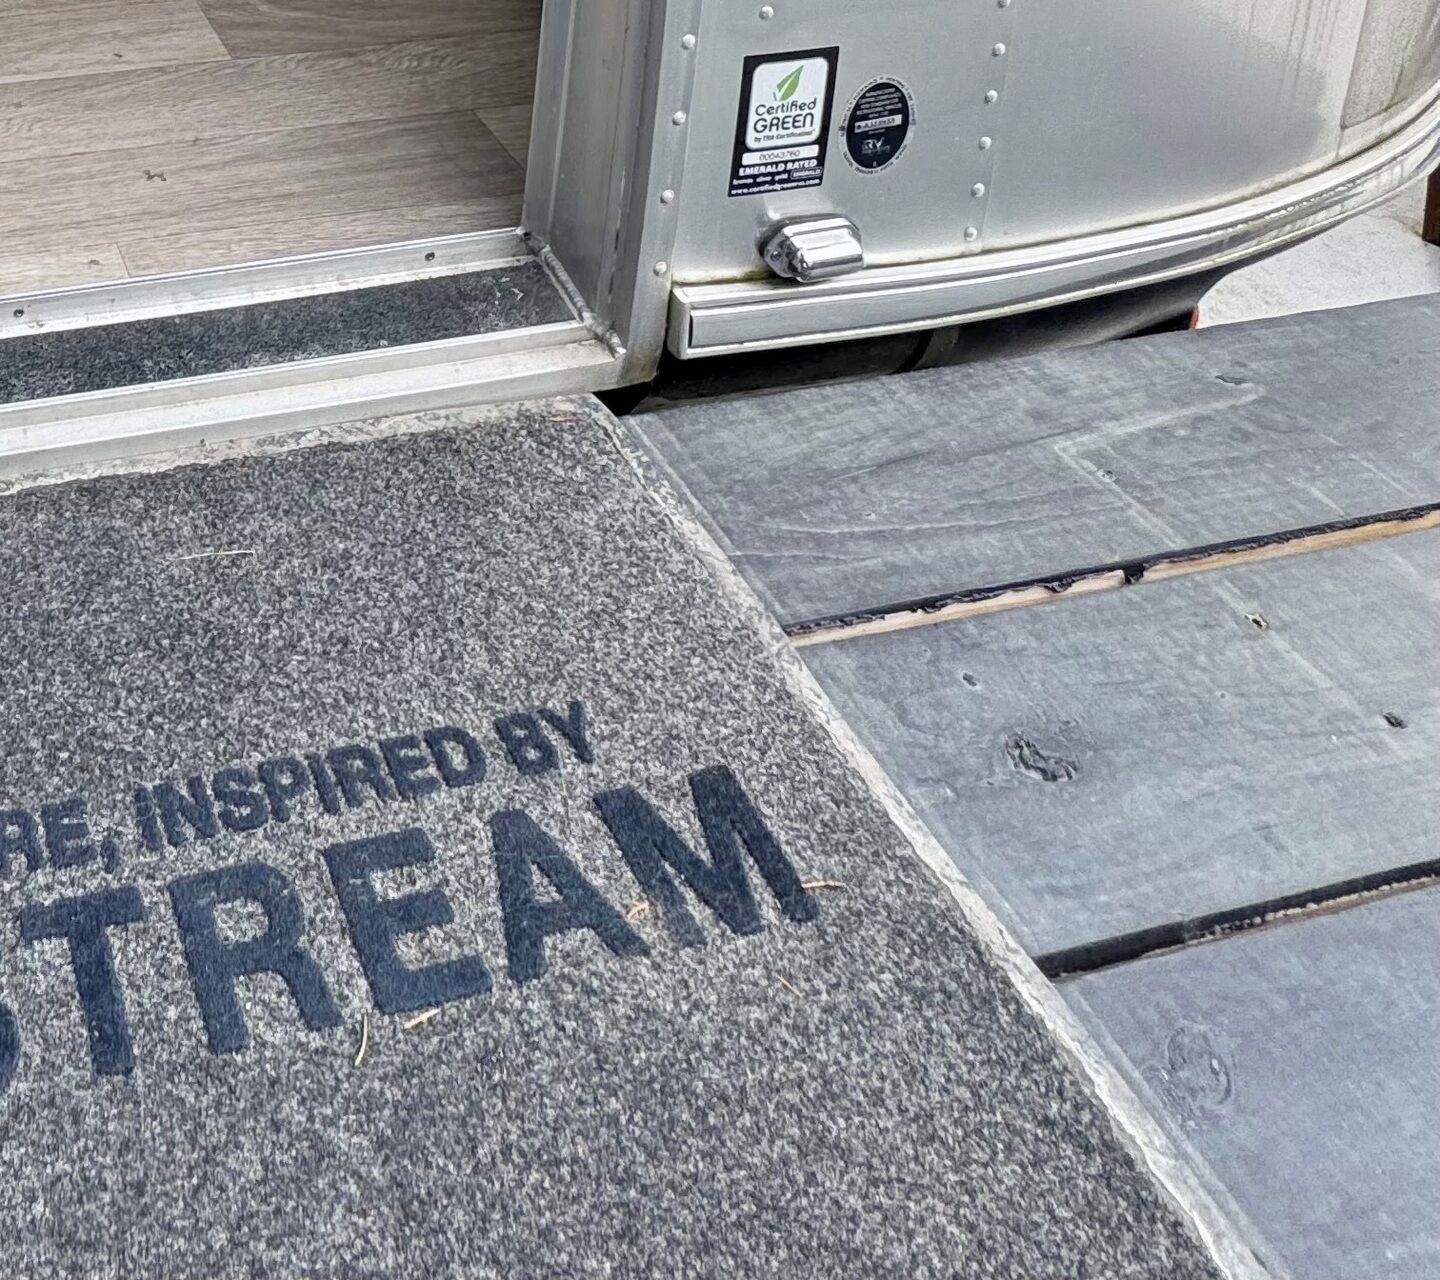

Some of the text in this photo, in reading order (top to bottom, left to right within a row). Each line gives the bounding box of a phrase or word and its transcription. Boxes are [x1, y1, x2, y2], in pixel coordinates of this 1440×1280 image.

[755, 98, 817, 116] Certified
[753, 113, 815, 134] GREEN
[738, 158, 818, 176] EMERALD RATED
[133, 724, 488, 845] INSPIRED
[492, 700, 600, 778] BY
